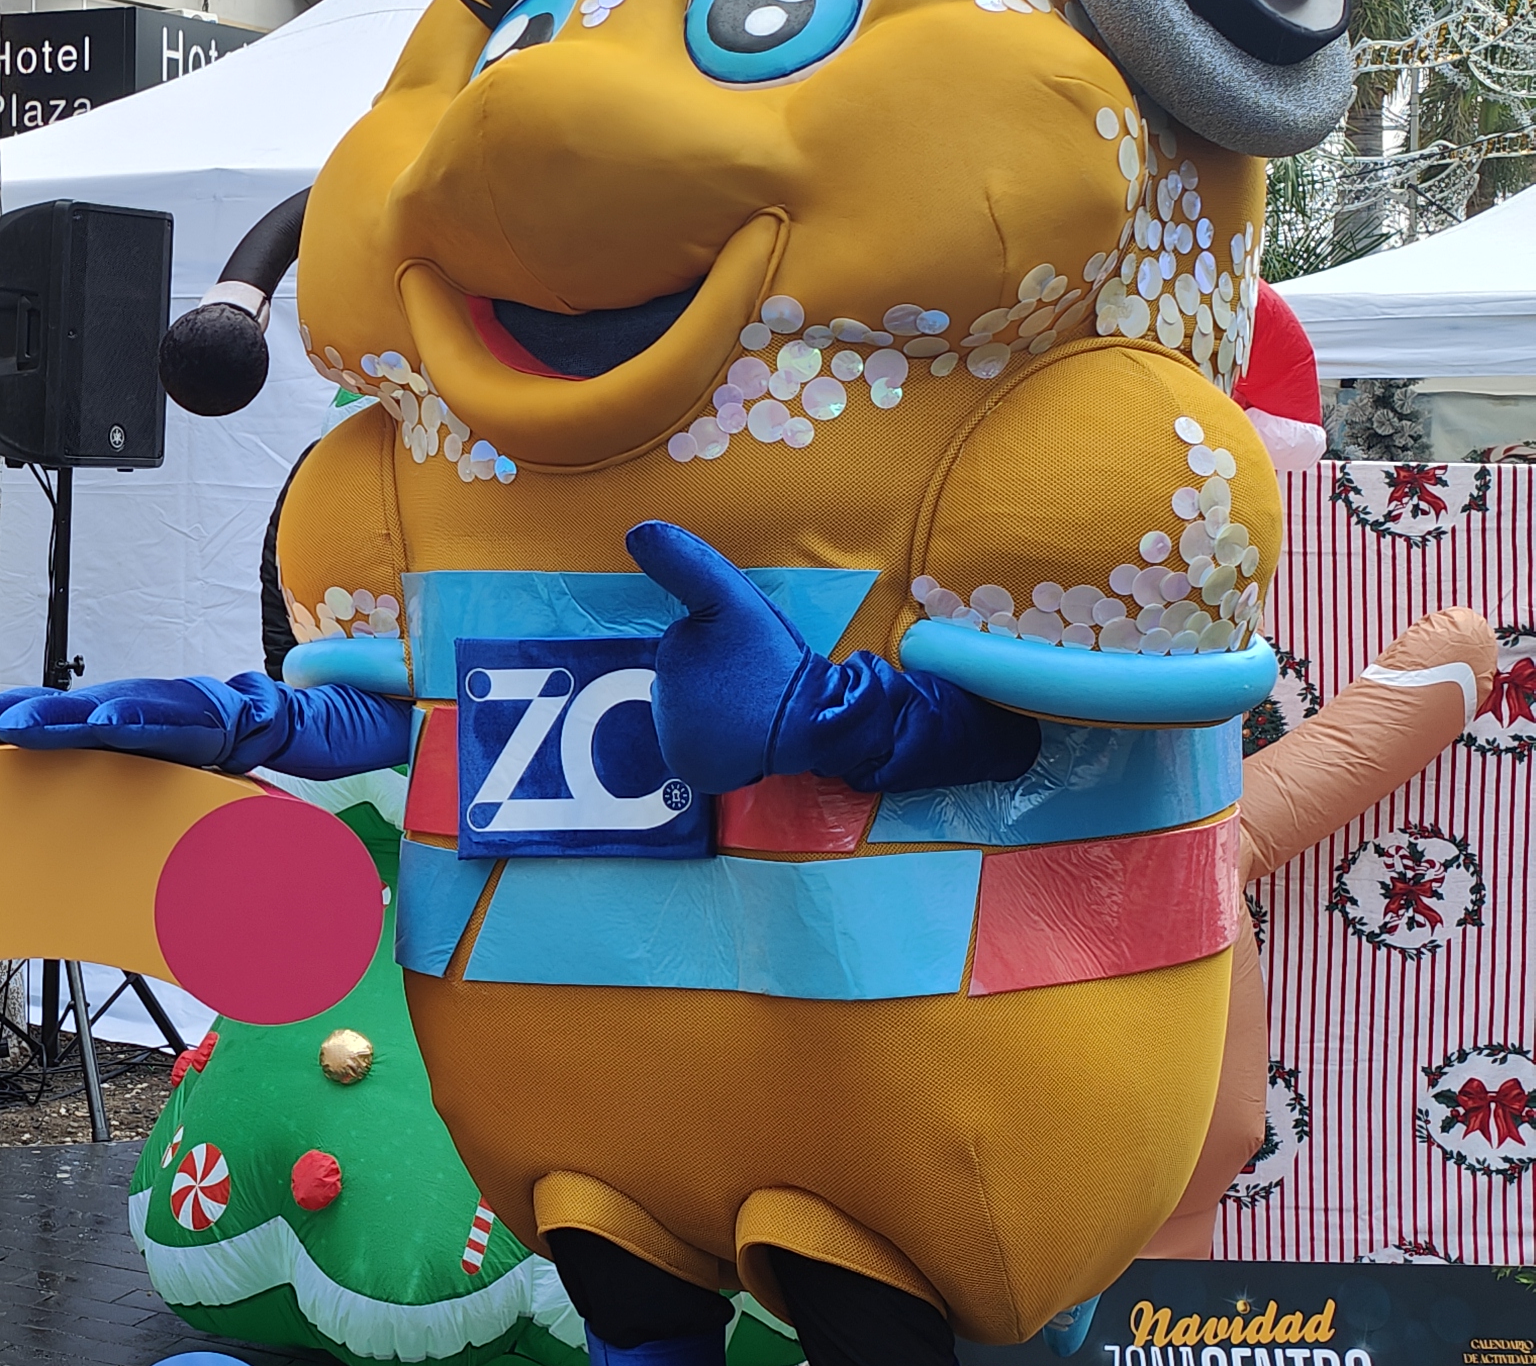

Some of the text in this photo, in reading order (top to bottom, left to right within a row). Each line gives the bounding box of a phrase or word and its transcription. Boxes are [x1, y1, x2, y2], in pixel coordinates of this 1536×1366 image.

[162, 26, 250, 82] Hot
[466, 668, 692, 833] ZC
[1130, 1298, 1336, 1348] Navidad
[1470, 1339, 1535, 1353] CALENDARIO
[1463, 1353, 1479, 1364] DE
